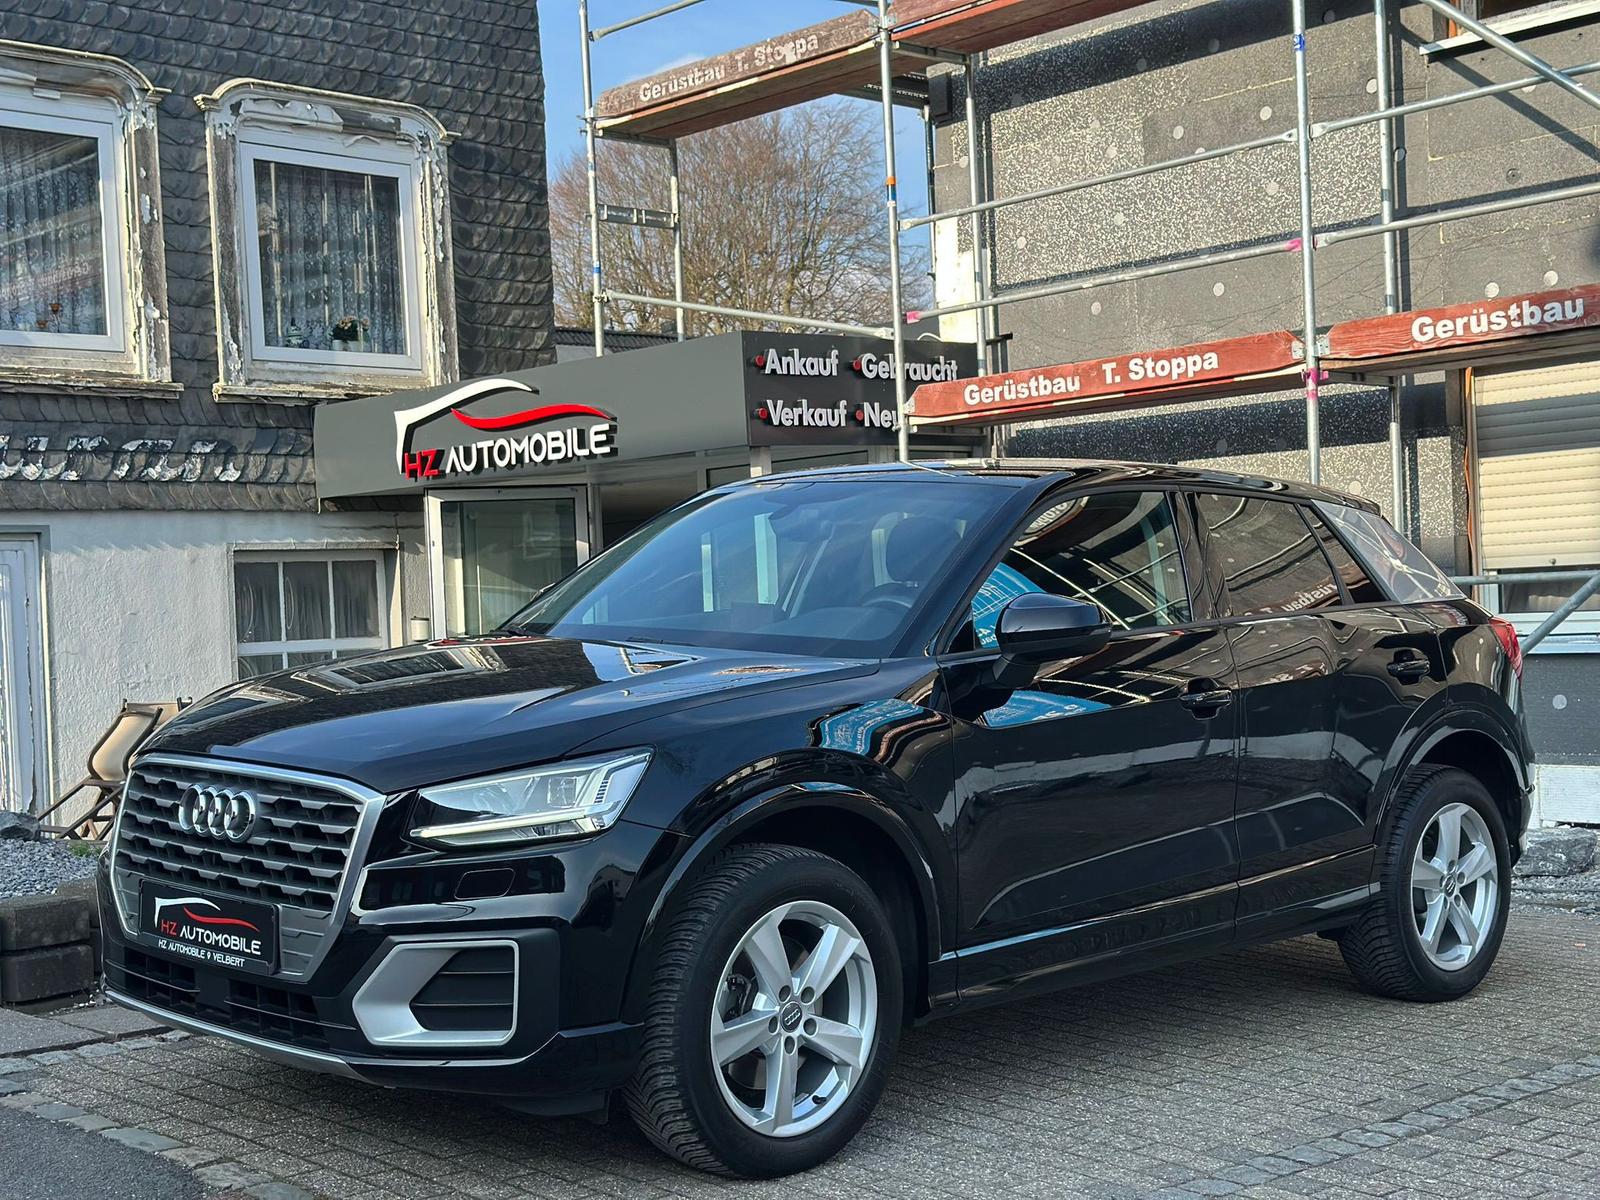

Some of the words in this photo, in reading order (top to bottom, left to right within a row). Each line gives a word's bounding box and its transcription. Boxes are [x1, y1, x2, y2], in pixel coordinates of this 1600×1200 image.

[639, 65, 726, 102] Gerüstbau
[1411, 298, 1585, 342] Gerüstbau
[765, 348, 839, 377] Ankauf
[963, 374, 1081, 406] Gerüstbau
[1101, 363, 1121, 386] T.
[1128, 351, 1219, 383] Stoppa
[766, 399, 847, 427] Verkauf
[404, 448, 440, 480] HZ
[446, 423, 612, 474] AUTOMOBILE
[158, 939, 167, 949] HZ
[168, 941, 205, 960] AUTOMOBILE
[213, 953, 246, 968] VELBERT
[160, 919, 177, 936] HZ
[180, 925, 262, 956] AUTOMOBILE
